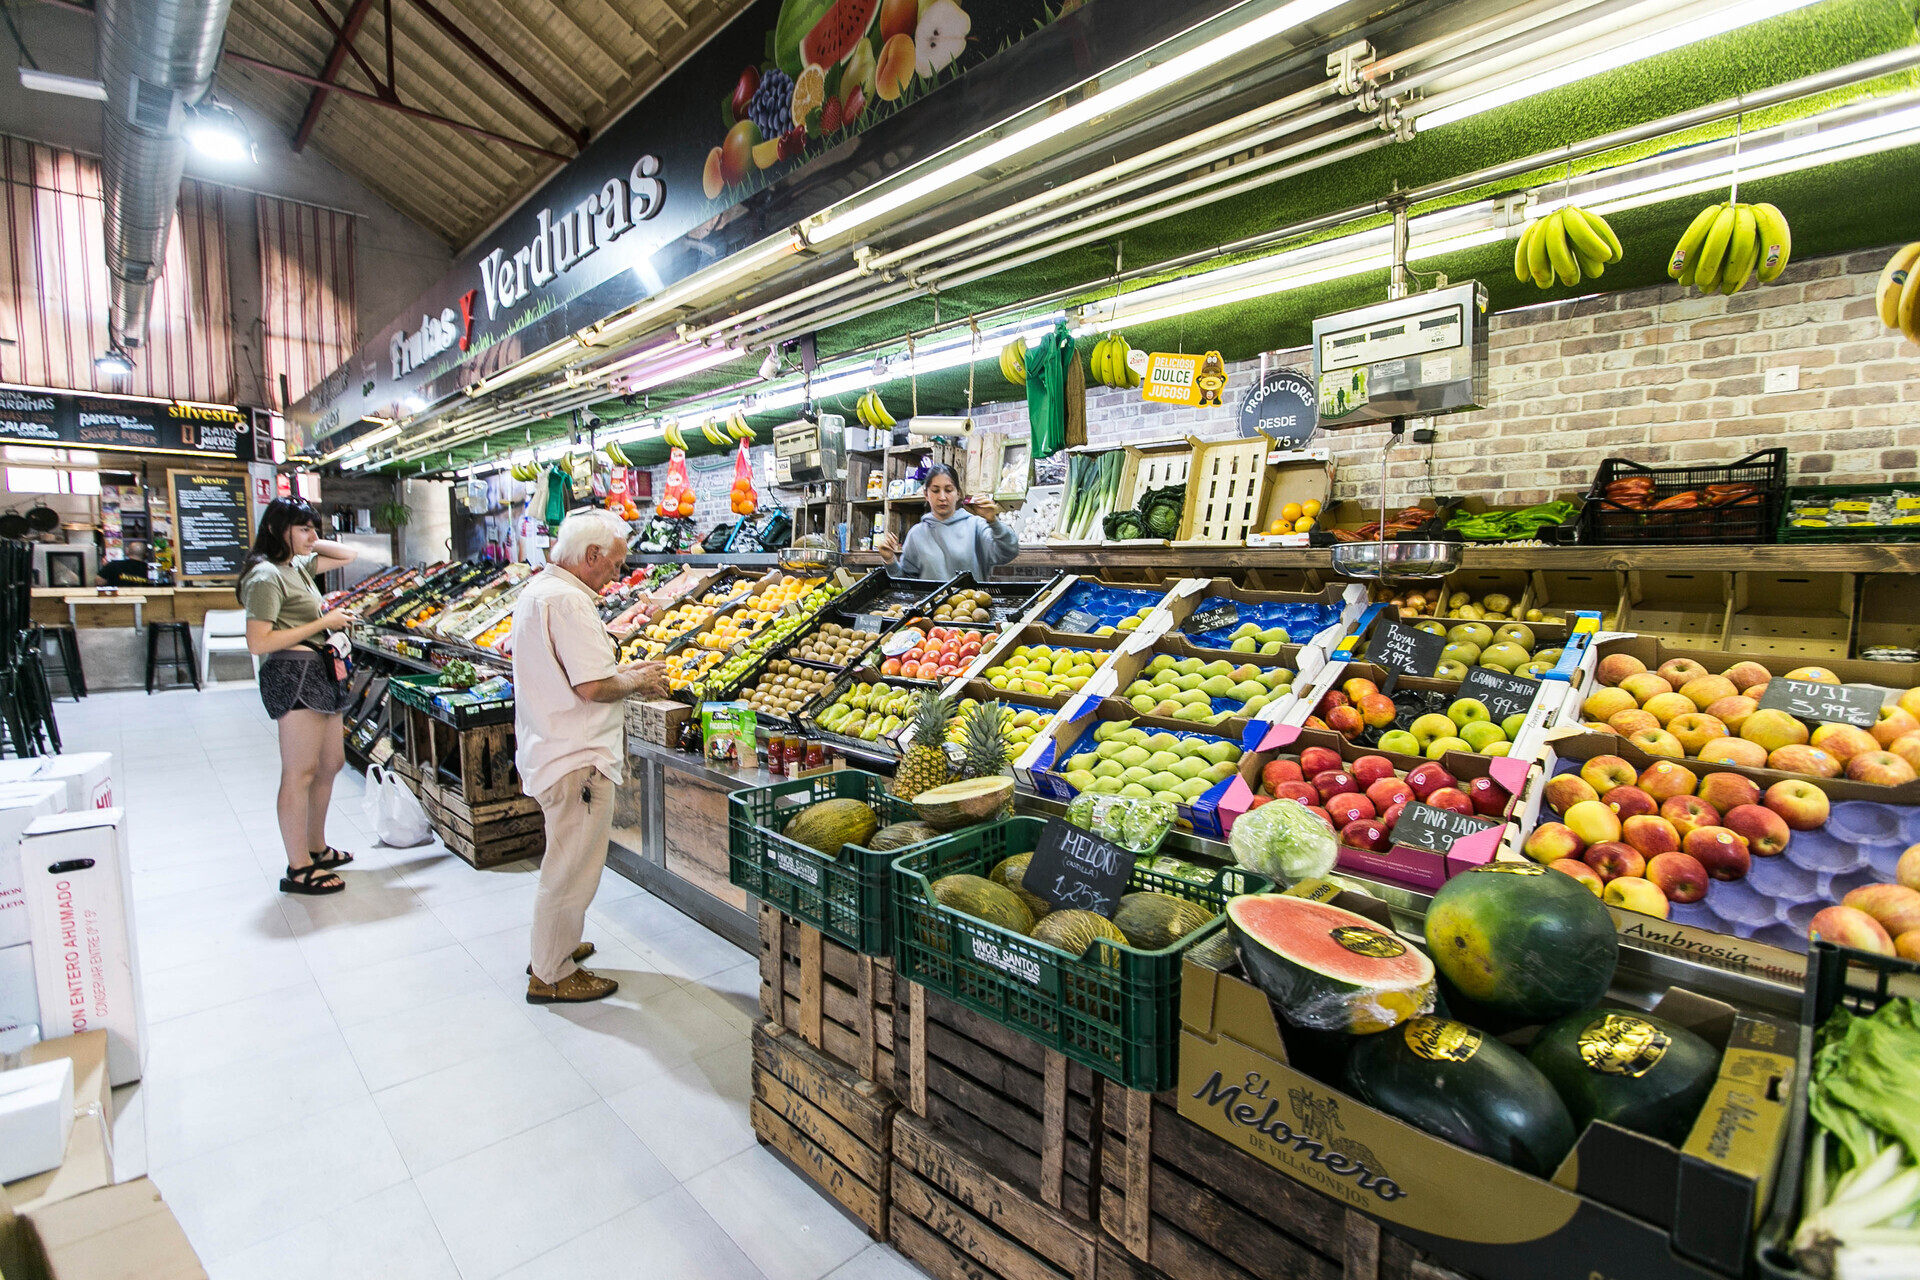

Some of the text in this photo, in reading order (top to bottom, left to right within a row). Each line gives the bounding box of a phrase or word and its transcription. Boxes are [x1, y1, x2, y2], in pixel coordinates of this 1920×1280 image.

[390, 307, 456, 381] Frutas
[478, 154, 667, 321] Verduras
[1154, 356, 1195, 370] DELICIOSO
[1153, 368, 1190, 384] DULCE
[1148, 385, 1190, 400] JUGOSO
[1245, 380, 1315, 414] PRODUCTORES
[168, 404, 247, 424] silvestre
[1258, 416, 1296, 429] DESDE
[195, 436, 236, 450] NUEVOS
[200, 425, 237, 439] PLATOS
[1386, 640, 1412, 655] GALA
[1388, 624, 1416, 646] ROYAL
[1470, 670, 1535, 696] GRANNY SMITH
[1786, 681, 1852, 702] FUJI
[1412, 806, 1448, 830] PINK
[777, 852, 794, 868] HNOS.
[796, 860, 818, 879] SANTOS
[56, 880, 78, 948] AHUMADO
[1624, 923, 1749, 963] Ambrosia
[972, 936, 1000, 960] HNOS.
[1002, 950, 1040, 976] SANTOS
[64, 952, 84, 1006] ENTERO
[1244, 1070, 1270, 1100] El
[1192, 1070, 1408, 1202] Melonero
[1250, 1134, 1370, 1209] DE VILLACONEJOS
